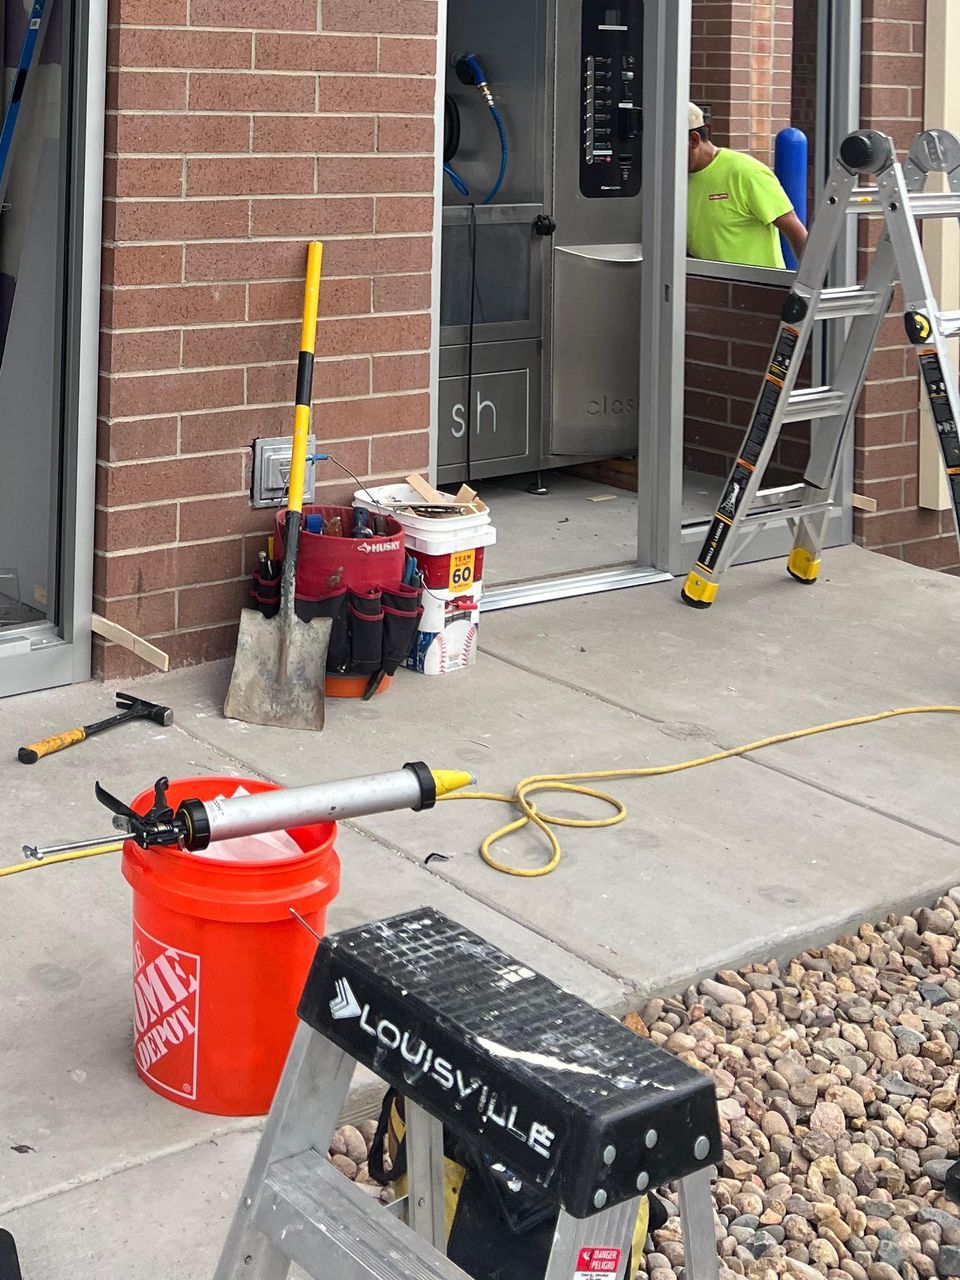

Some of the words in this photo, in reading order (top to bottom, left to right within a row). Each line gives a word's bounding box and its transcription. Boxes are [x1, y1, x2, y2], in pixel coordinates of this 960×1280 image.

[371, 540, 401, 553] HUSKY
[454, 554, 472, 563] TEAM
[452, 566, 472, 584] 60
[134, 949, 199, 1034] OME
[137, 1005, 197, 1071] DEPOT
[359, 1003, 556, 1159] LOUISVILLE
[592, 1250, 618, 1260] DANGER
